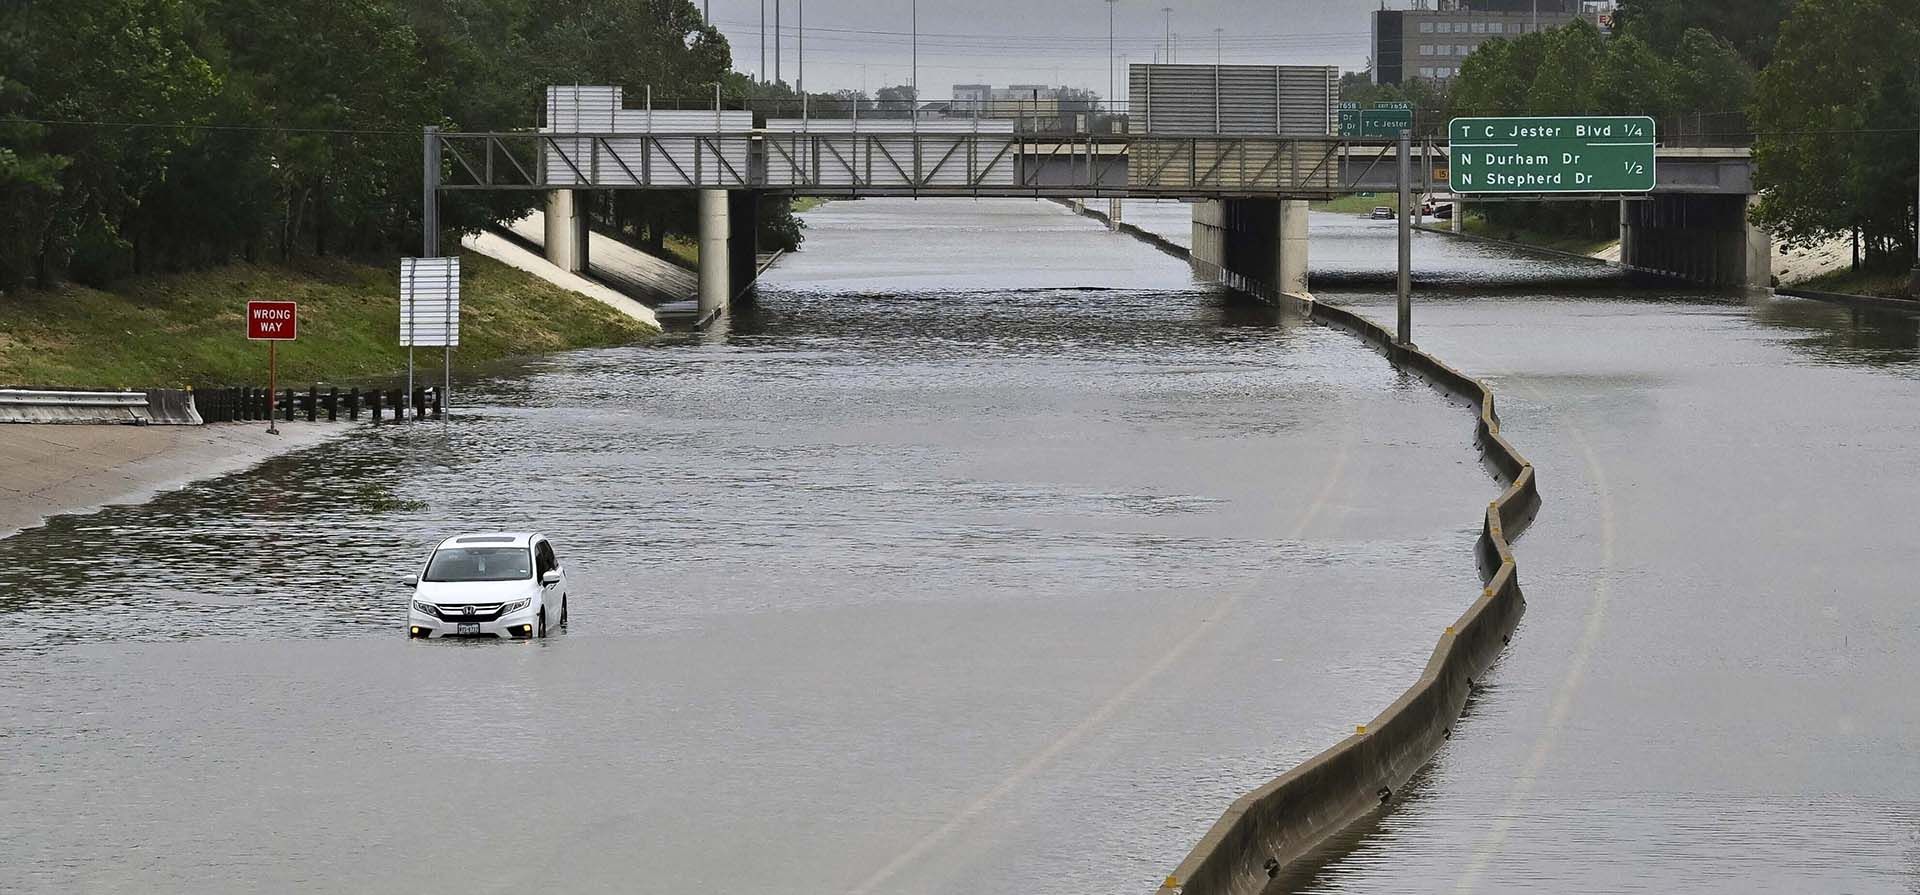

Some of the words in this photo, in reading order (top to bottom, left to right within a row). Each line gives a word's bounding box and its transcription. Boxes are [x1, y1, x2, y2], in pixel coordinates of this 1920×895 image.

[1462, 126, 1470, 137] T
[1485, 126, 1494, 137] C
[1509, 125, 1561, 137] Jester
[1576, 125, 1611, 136] Blvd
[1624, 124, 1643, 137] 1/4
[1462, 154, 1472, 165] N
[1486, 153, 1549, 165] Durham
[1563, 153, 1581, 164] Dr
[1624, 161, 1643, 174] 1/2
[1462, 173, 1472, 184] N
[1486, 173, 1561, 187] Shepherd
[1575, 173, 1593, 184] Dr
[253, 309, 291, 319] WRONG
[260, 322, 282, 332] WAY
